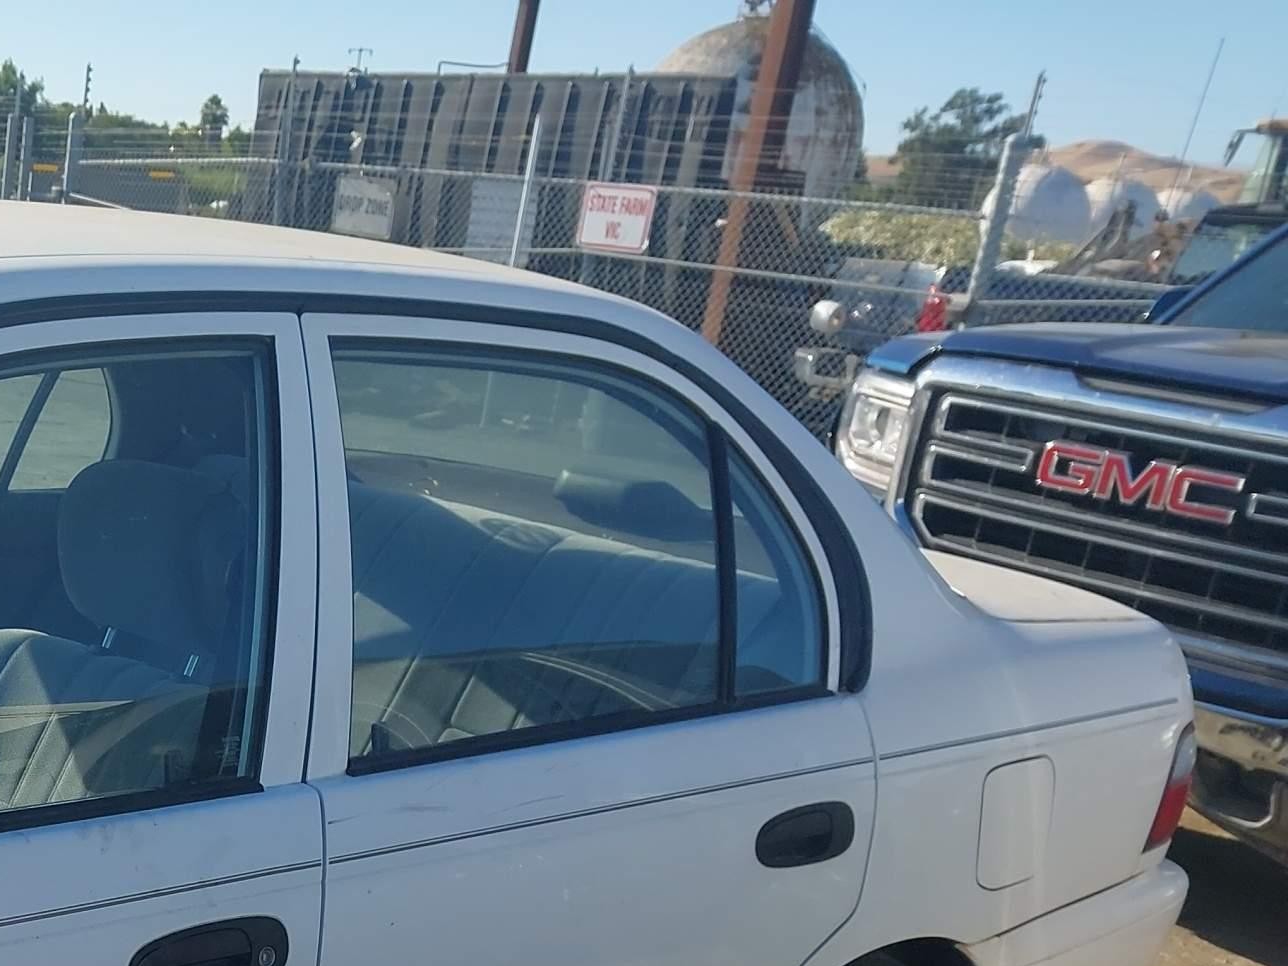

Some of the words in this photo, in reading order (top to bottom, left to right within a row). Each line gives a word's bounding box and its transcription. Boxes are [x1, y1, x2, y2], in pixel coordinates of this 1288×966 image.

[588, 193, 619, 213] STATE
[619, 195, 649, 216] FARM
[605, 219, 622, 239] VIC
[1036, 439, 1246, 526] GMC
